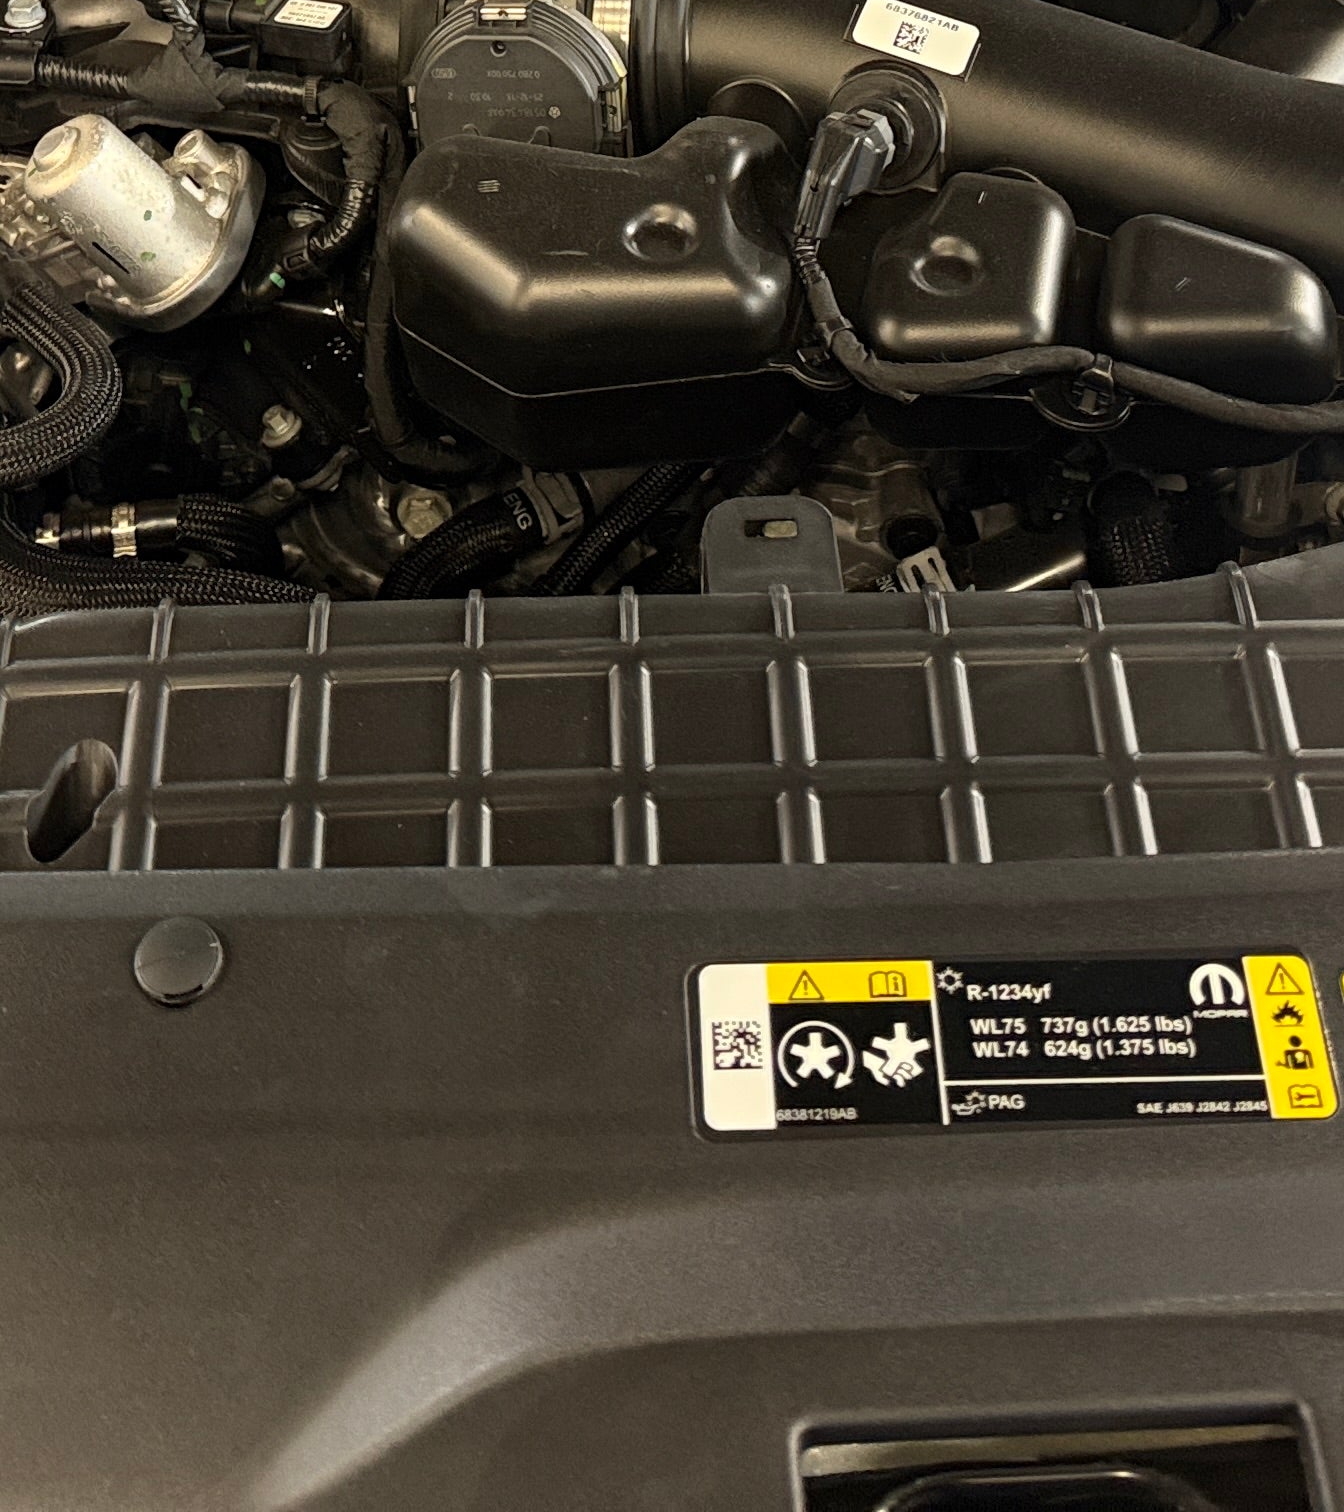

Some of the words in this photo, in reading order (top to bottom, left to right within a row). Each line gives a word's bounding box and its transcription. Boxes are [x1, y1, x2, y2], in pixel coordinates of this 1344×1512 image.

[503, 492, 533, 531] ENG
[966, 983, 1052, 1004] R-1234yf
[1192, 1009, 1249, 1019] MOPAR
[970, 1017, 1027, 1035] WL75
[1040, 1016, 1089, 1037] 737g
[1092, 1015, 1151, 1037] (1.625
[1155, 1015, 1193, 1036] lbs)
[972, 1040, 1030, 1058] WL74
[1044, 1039, 1093, 1060] 624g
[1096, 1038, 1155, 1060] (1.375
[1158, 1037, 1197, 1059] lbs)
[987, 1094, 1026, 1110] PAG
[1136, 1102, 1164, 1114] SAE
[1166, 1102, 1195, 1113] J639
